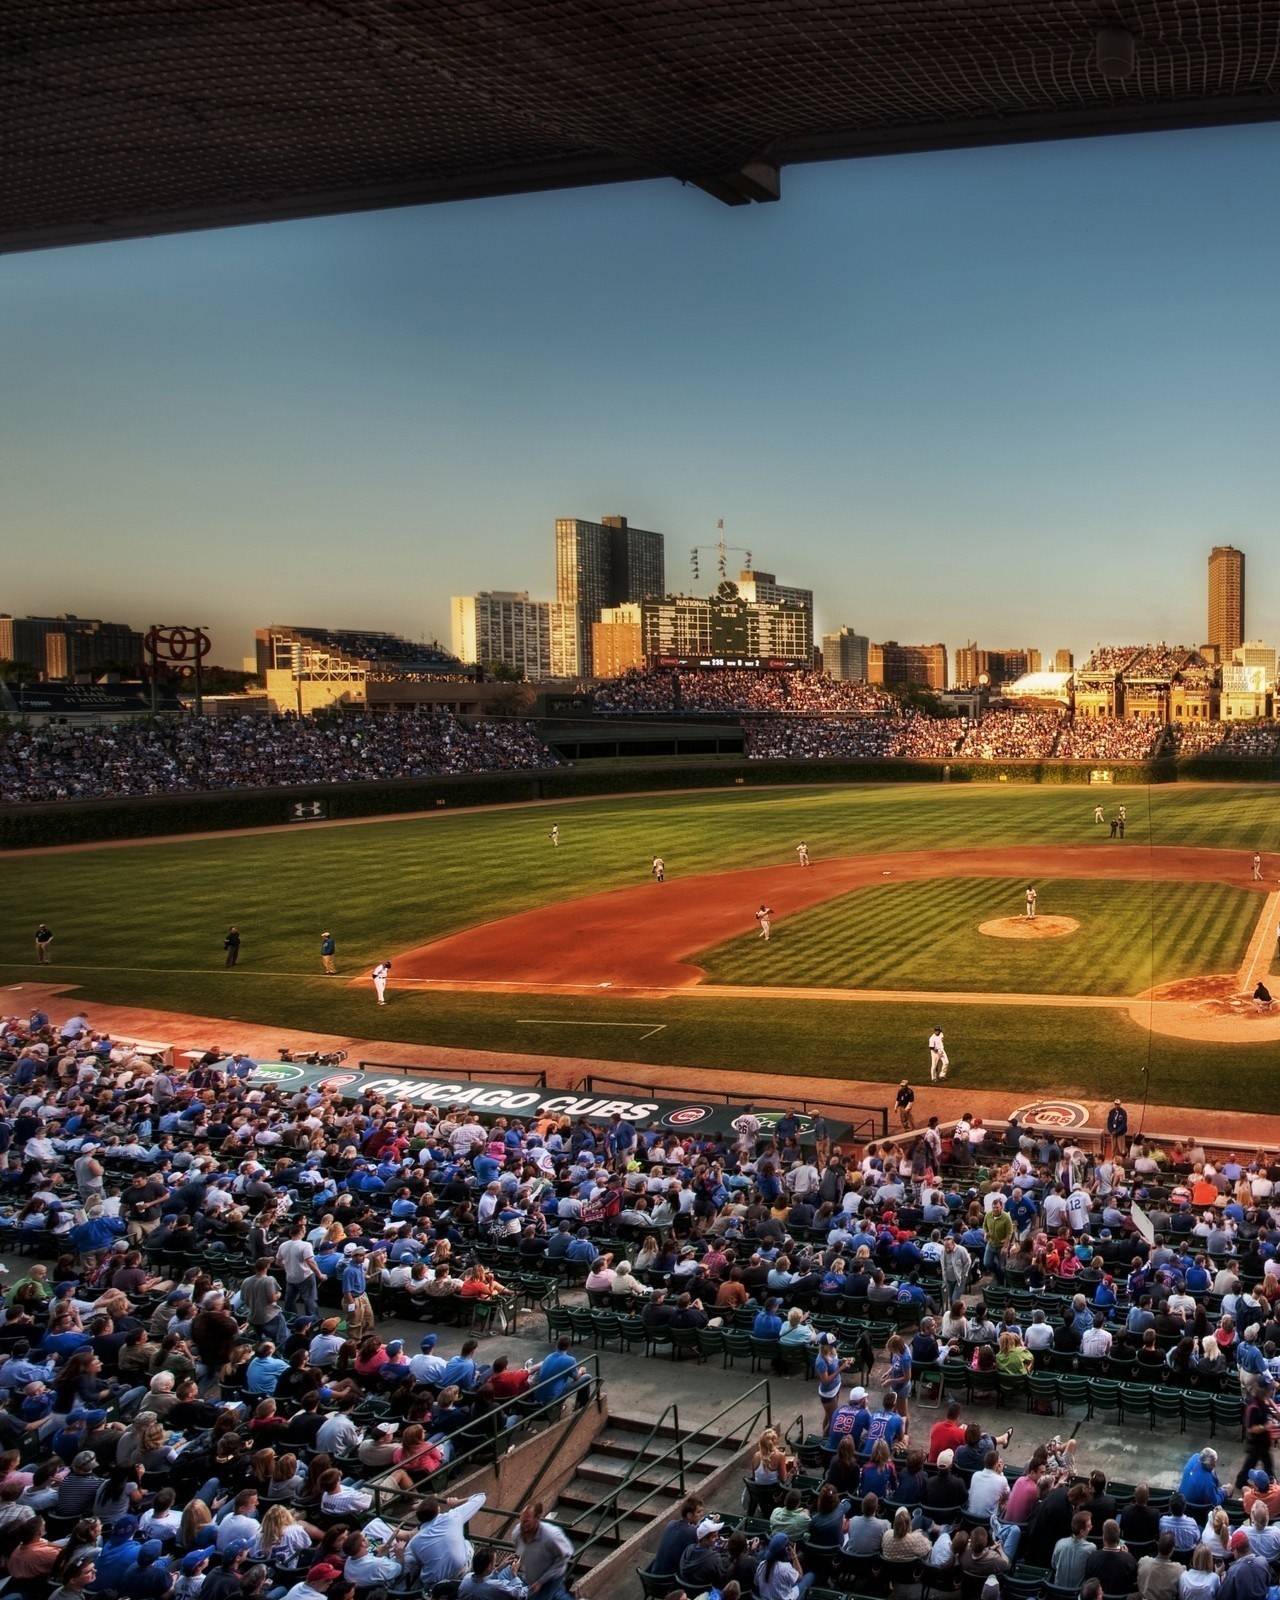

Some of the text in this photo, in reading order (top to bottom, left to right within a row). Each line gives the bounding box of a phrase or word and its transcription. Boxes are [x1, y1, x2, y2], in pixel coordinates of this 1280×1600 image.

[677, 599, 711, 608] NATIONAL
[747, 603, 779, 611] AMERICAN
[358, 1079, 541, 1110] CHICAGO
[538, 1096, 660, 1121] CUBS
[1070, 1199, 1081, 1211] 12
[832, 1413, 854, 1434] 29
[869, 1420, 887, 1440] 21
